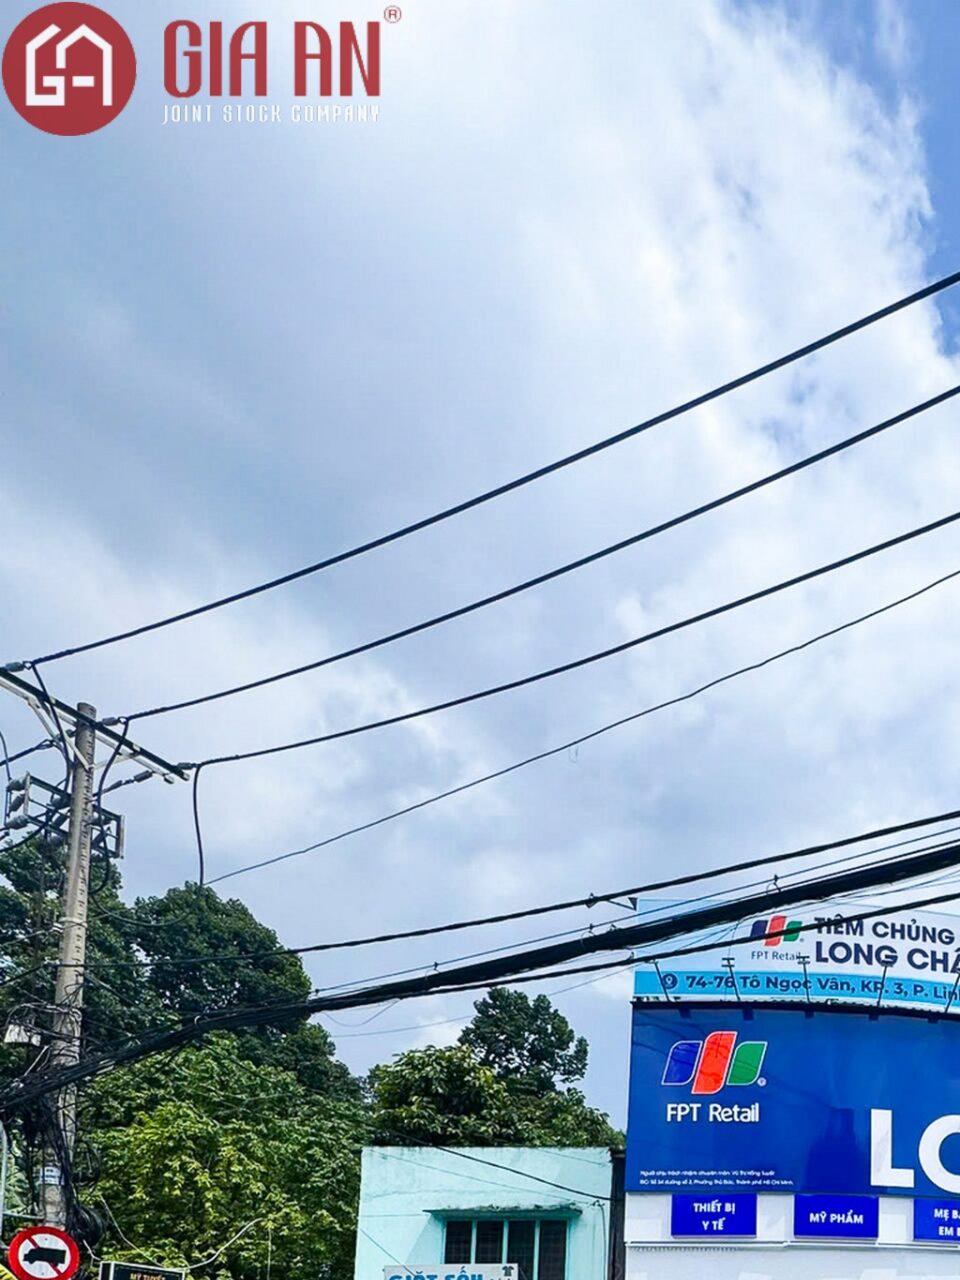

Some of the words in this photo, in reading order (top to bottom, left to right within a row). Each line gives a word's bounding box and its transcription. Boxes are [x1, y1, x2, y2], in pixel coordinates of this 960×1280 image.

[872, 918, 955, 945] CHỦNG
[751, 951, 768, 960] FPT
[815, 941, 898, 966] LONG
[686, 975, 735, 989] 74-76
[740, 974, 760, 989] Tô
[766, 976, 811, 992] Ngọc
[817, 977, 855, 993] Vân,
[894, 982, 908, 996] 3,
[913, 984, 928, 997] P.
[666, 1103, 701, 1122] FPT
[709, 1102, 760, 1122] Retail
[693, 1200, 722, 1213] THIẾT
[724, 1202, 735, 1214] BỊ
[809, 1211, 827, 1224] MỸ
[830, 1209, 864, 1225] PHẨM
[934, 1208, 949, 1222] MẸ
[702, 1220, 709, 1230] Y
[712, 1217, 726, 1230] TẾ
[938, 1226, 954, 1236] EM
